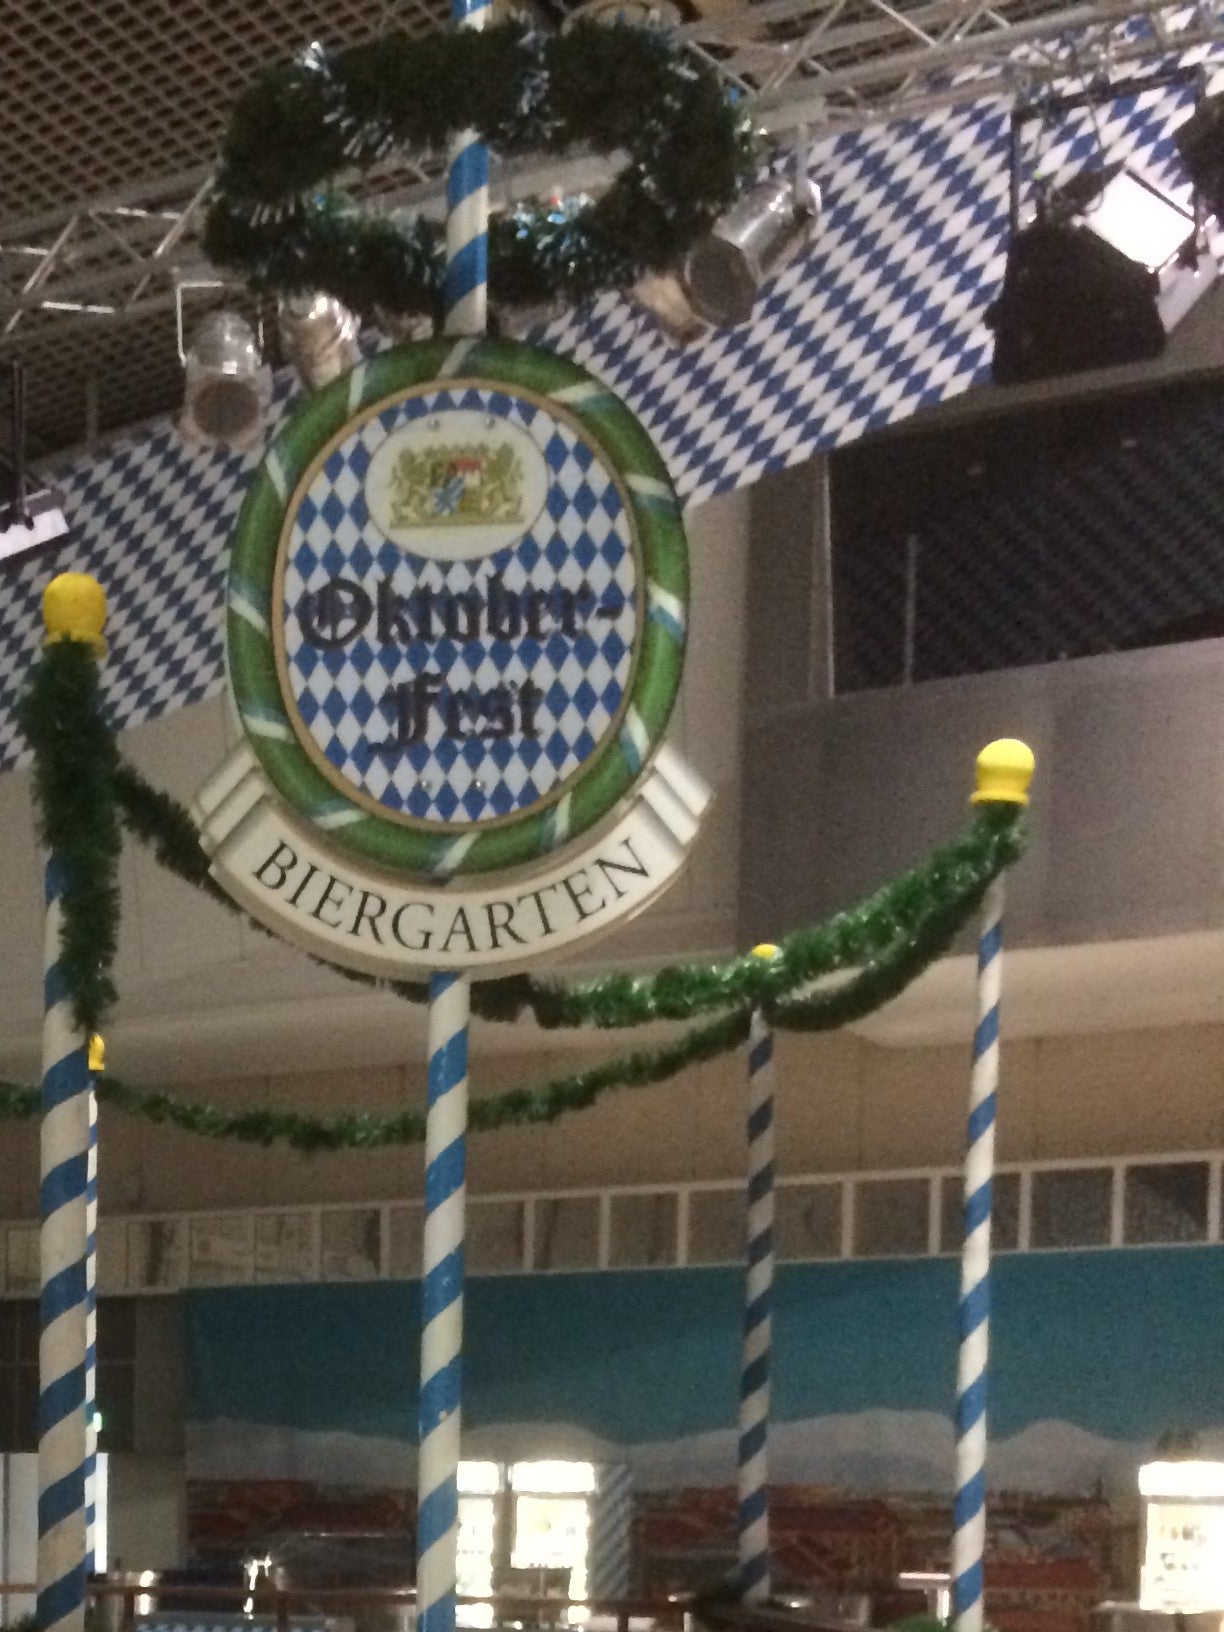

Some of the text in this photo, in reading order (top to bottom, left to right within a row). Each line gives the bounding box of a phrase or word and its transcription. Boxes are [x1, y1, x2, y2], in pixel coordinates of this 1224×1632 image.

[296, 575, 623, 647] Oktober-
[368, 672, 544, 754] Fest
[253, 836, 650, 953] BIERGARTEN
